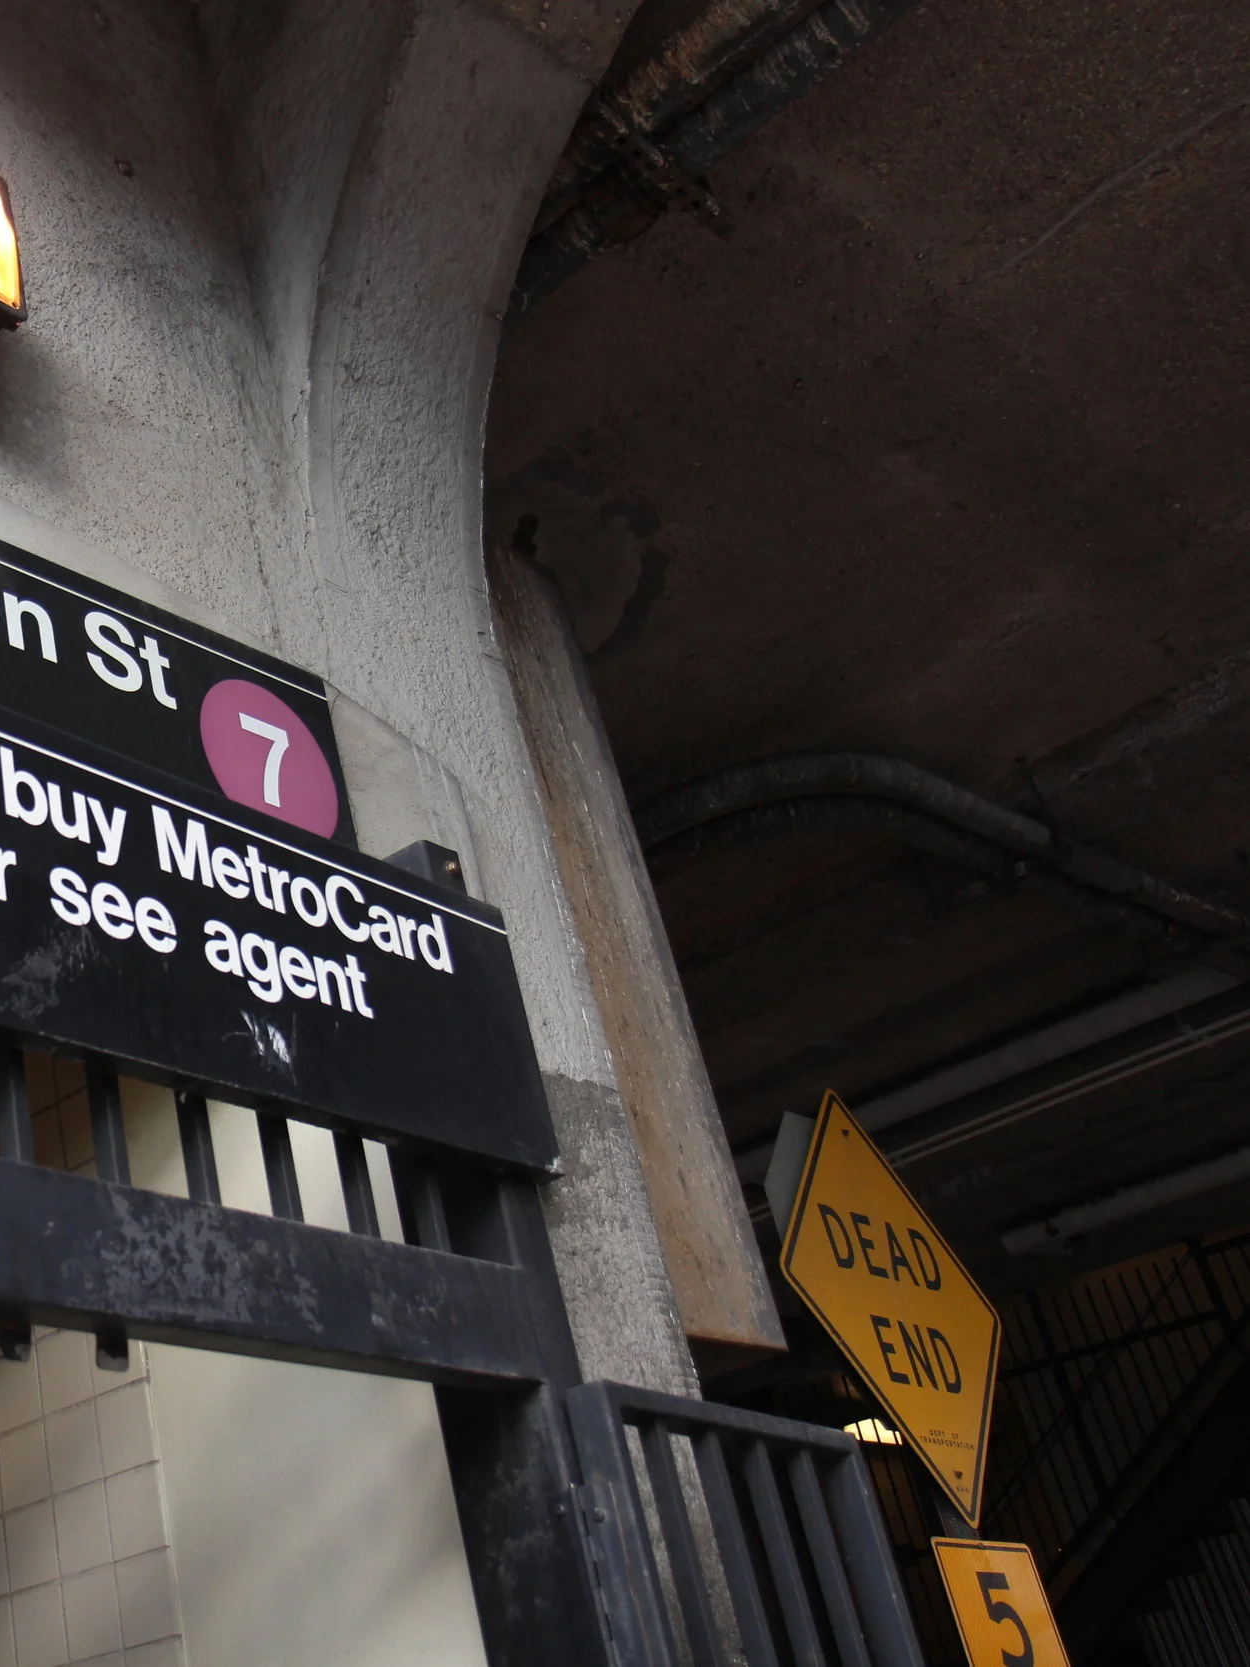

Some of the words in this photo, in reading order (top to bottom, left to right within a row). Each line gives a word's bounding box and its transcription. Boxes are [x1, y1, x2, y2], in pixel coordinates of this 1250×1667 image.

[84, 610, 178, 711] St
[238, 710, 291, 809] 7
[0, 745, 127, 867] buy
[151, 803, 455, 974] MetroCard
[49, 866, 178, 955] see
[203, 918, 376, 1020] agent
[817, 1202, 942, 1292] DEAD
[869, 1313, 962, 1395] END
[919, 1435, 975, 1450] TRANSPORTATION
[975, 1571, 1034, 1667] 5
